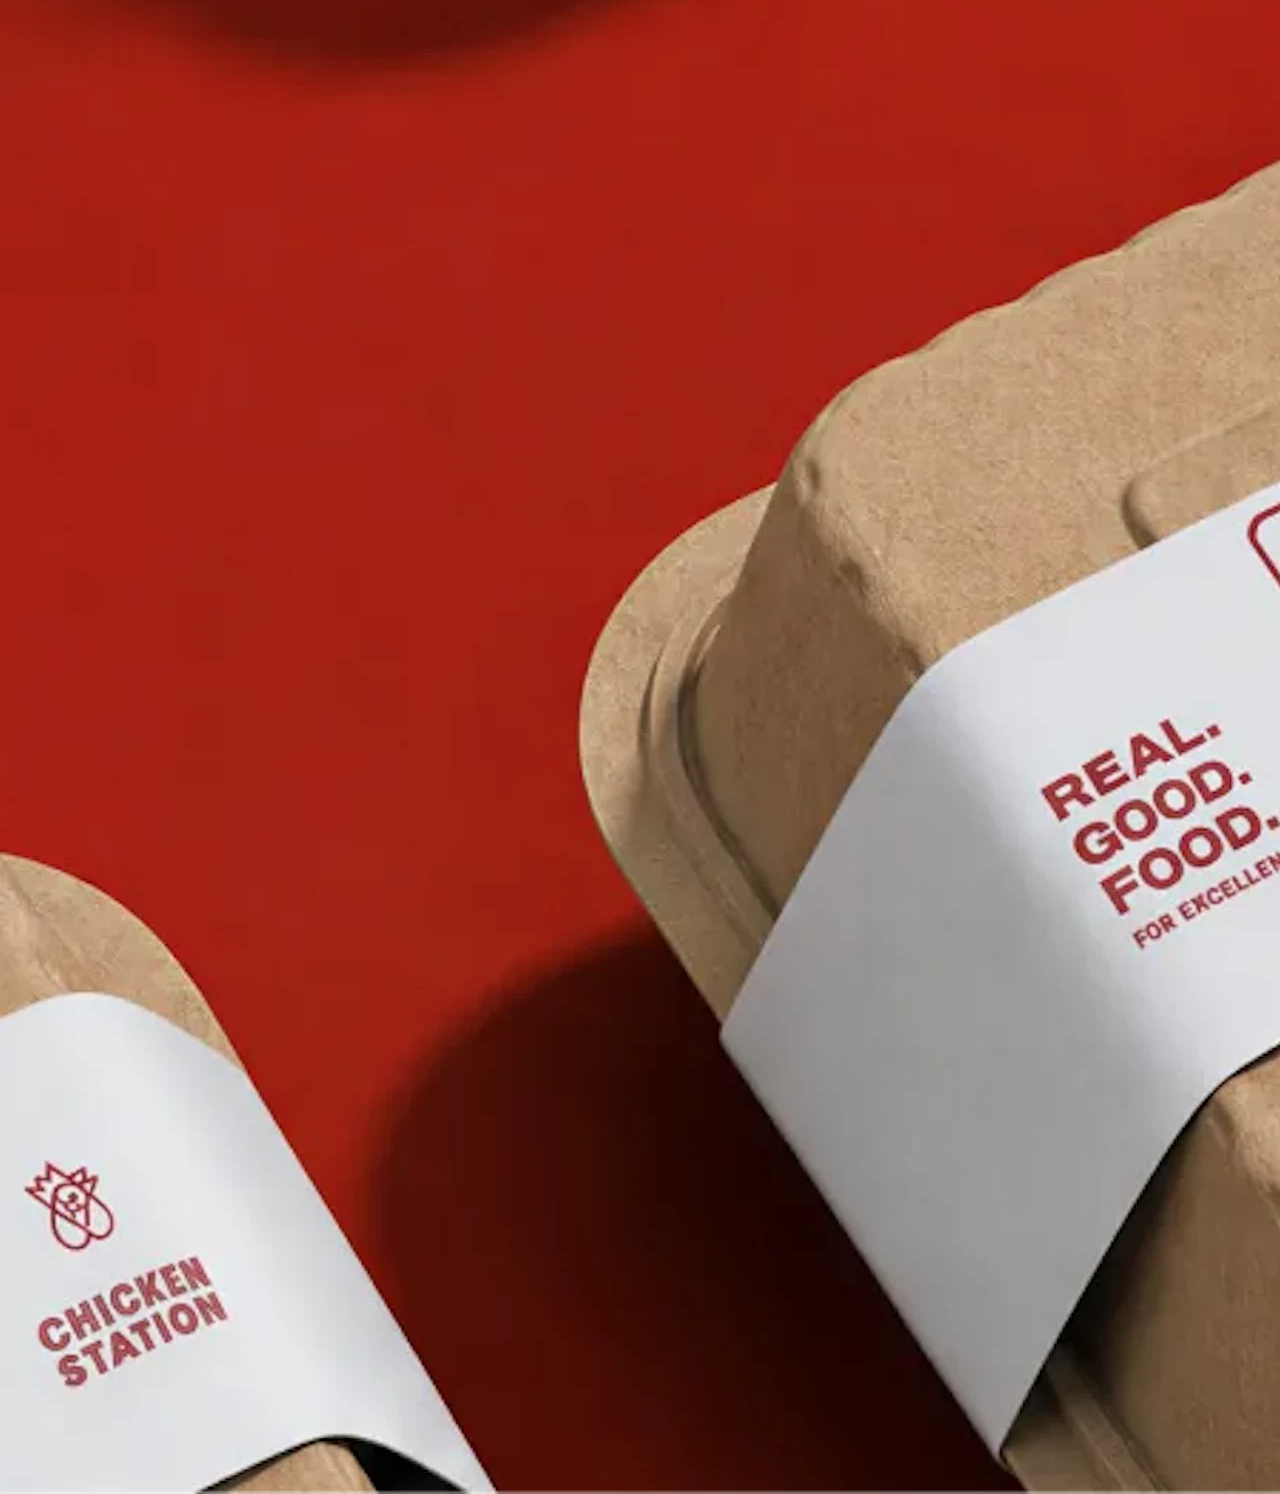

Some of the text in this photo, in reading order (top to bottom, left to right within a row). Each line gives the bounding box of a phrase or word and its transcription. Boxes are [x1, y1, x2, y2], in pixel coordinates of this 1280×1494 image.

[1041, 719, 1222, 821] REAL.
[1073, 760, 1252, 866] GOOD.
[1100, 806, 1280, 916] FOOD.
[1132, 914, 1177, 949] FOR
[38, 1257, 211, 1351] CHICKEN
[58, 1291, 228, 1389] STATION
